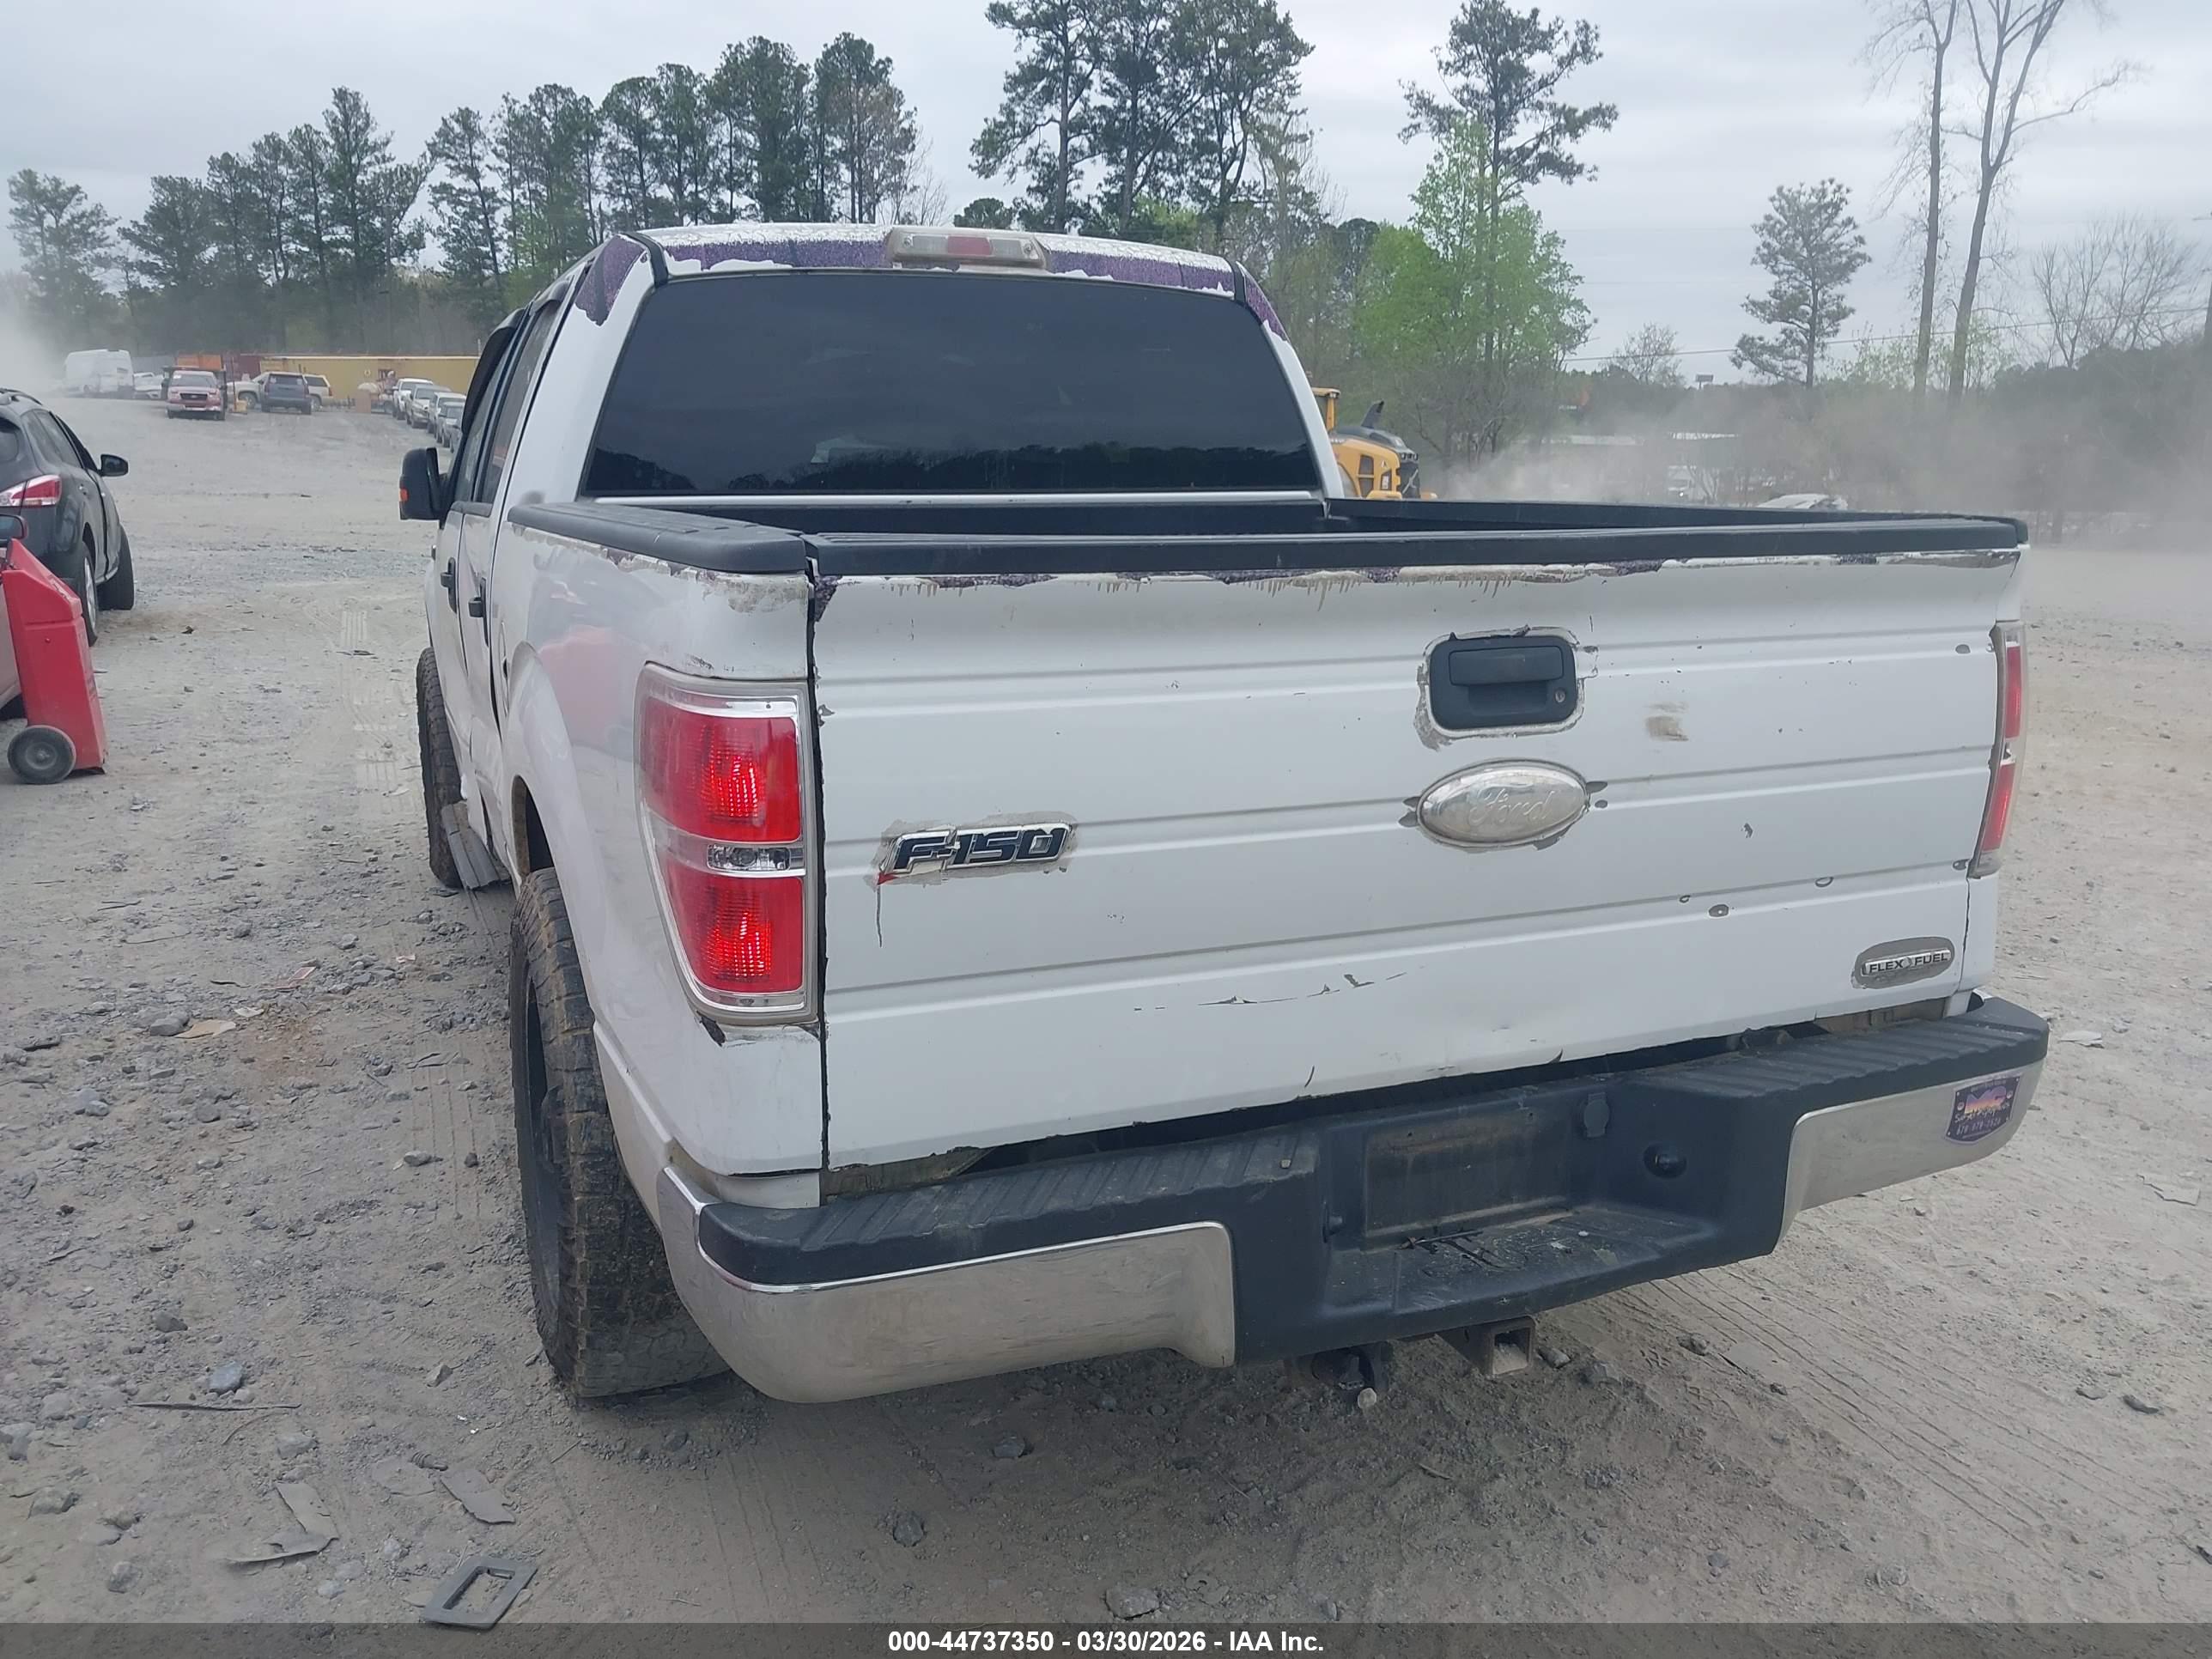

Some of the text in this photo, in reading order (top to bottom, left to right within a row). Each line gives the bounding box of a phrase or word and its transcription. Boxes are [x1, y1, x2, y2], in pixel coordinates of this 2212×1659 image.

[1468, 787, 1557, 827] Ford
[883, 823, 1072, 874] F-150
[1869, 952, 1949, 975] FLEX FUEL
